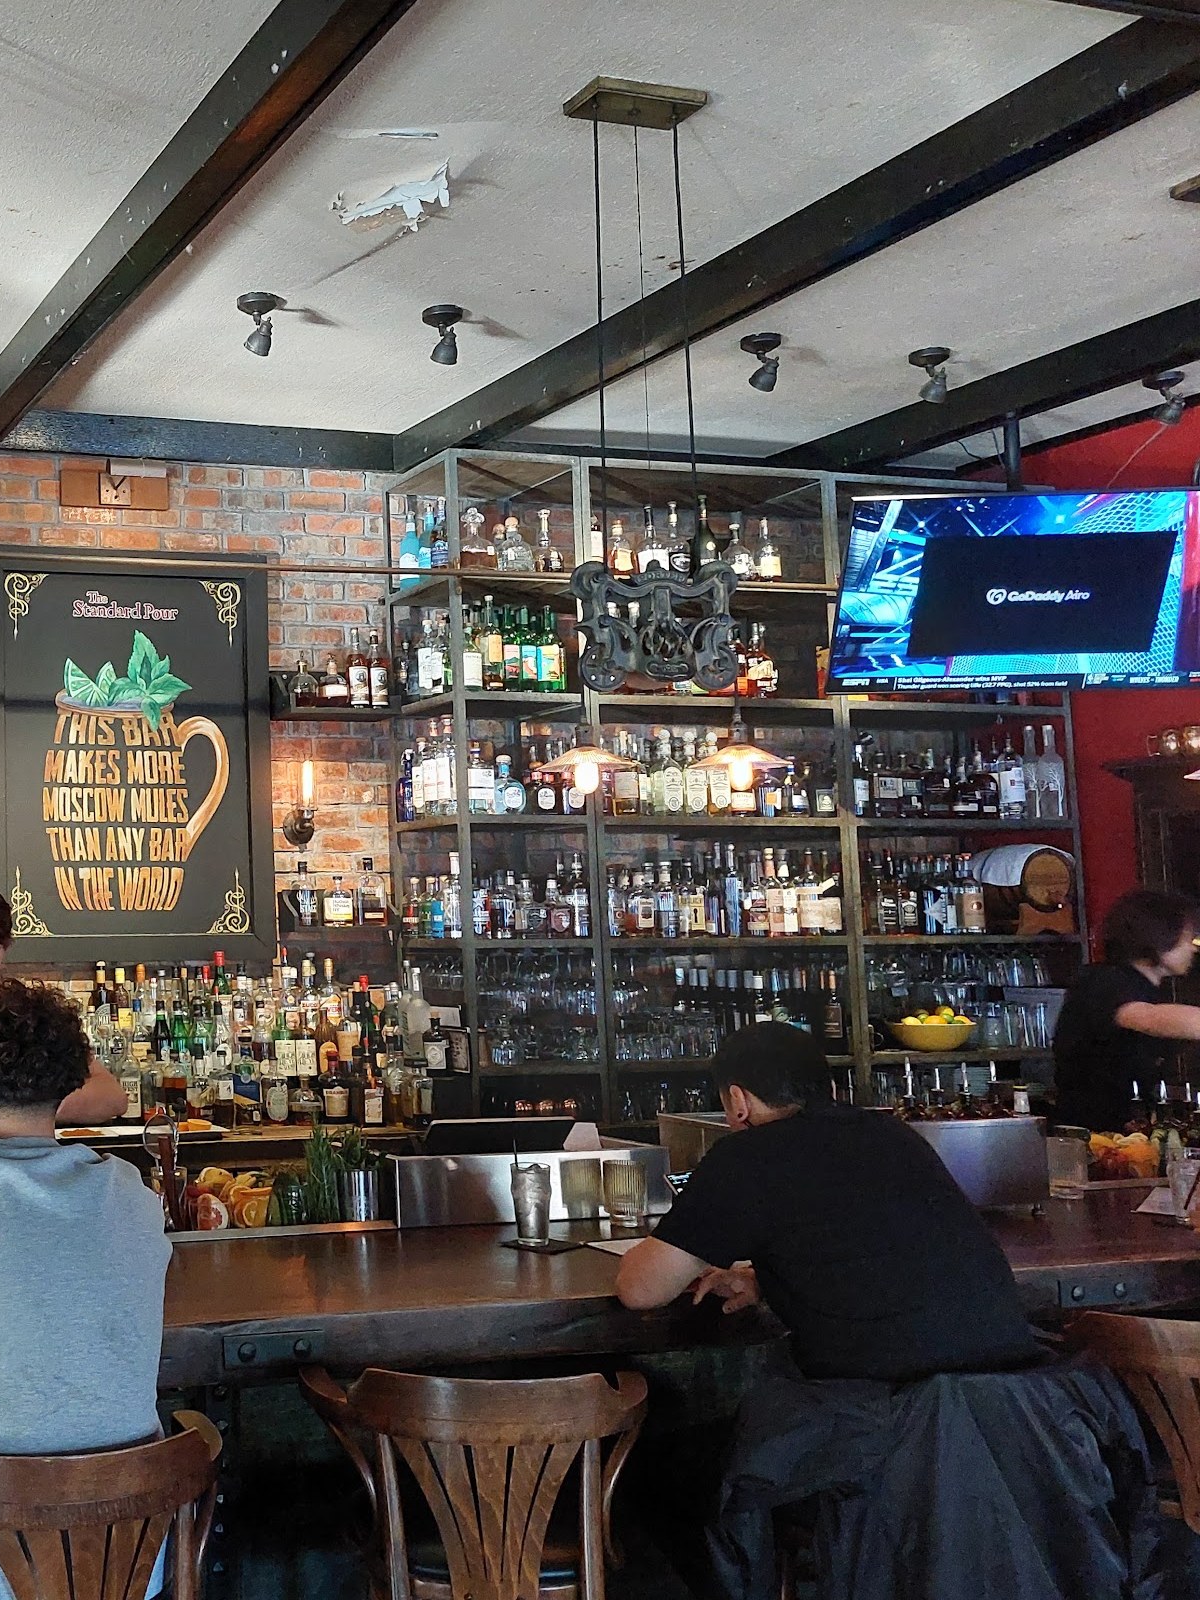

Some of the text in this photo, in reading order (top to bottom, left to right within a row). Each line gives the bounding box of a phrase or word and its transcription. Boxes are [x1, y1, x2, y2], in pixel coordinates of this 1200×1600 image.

[72, 600, 178, 620] Standard Pour
[85, 590, 108, 604] The
[1007, 589, 1090, 603] GoDaddy Airo
[842, 678, 870, 686] ESPN
[53, 713, 183, 747] THIS BAR
[44, 750, 186, 785] MAKES MORE
[43, 787, 189, 823] MOSCOW MULES
[46, 827, 188, 862] THAN ANY BAR
[55, 867, 185, 911] IN THE WORLD
